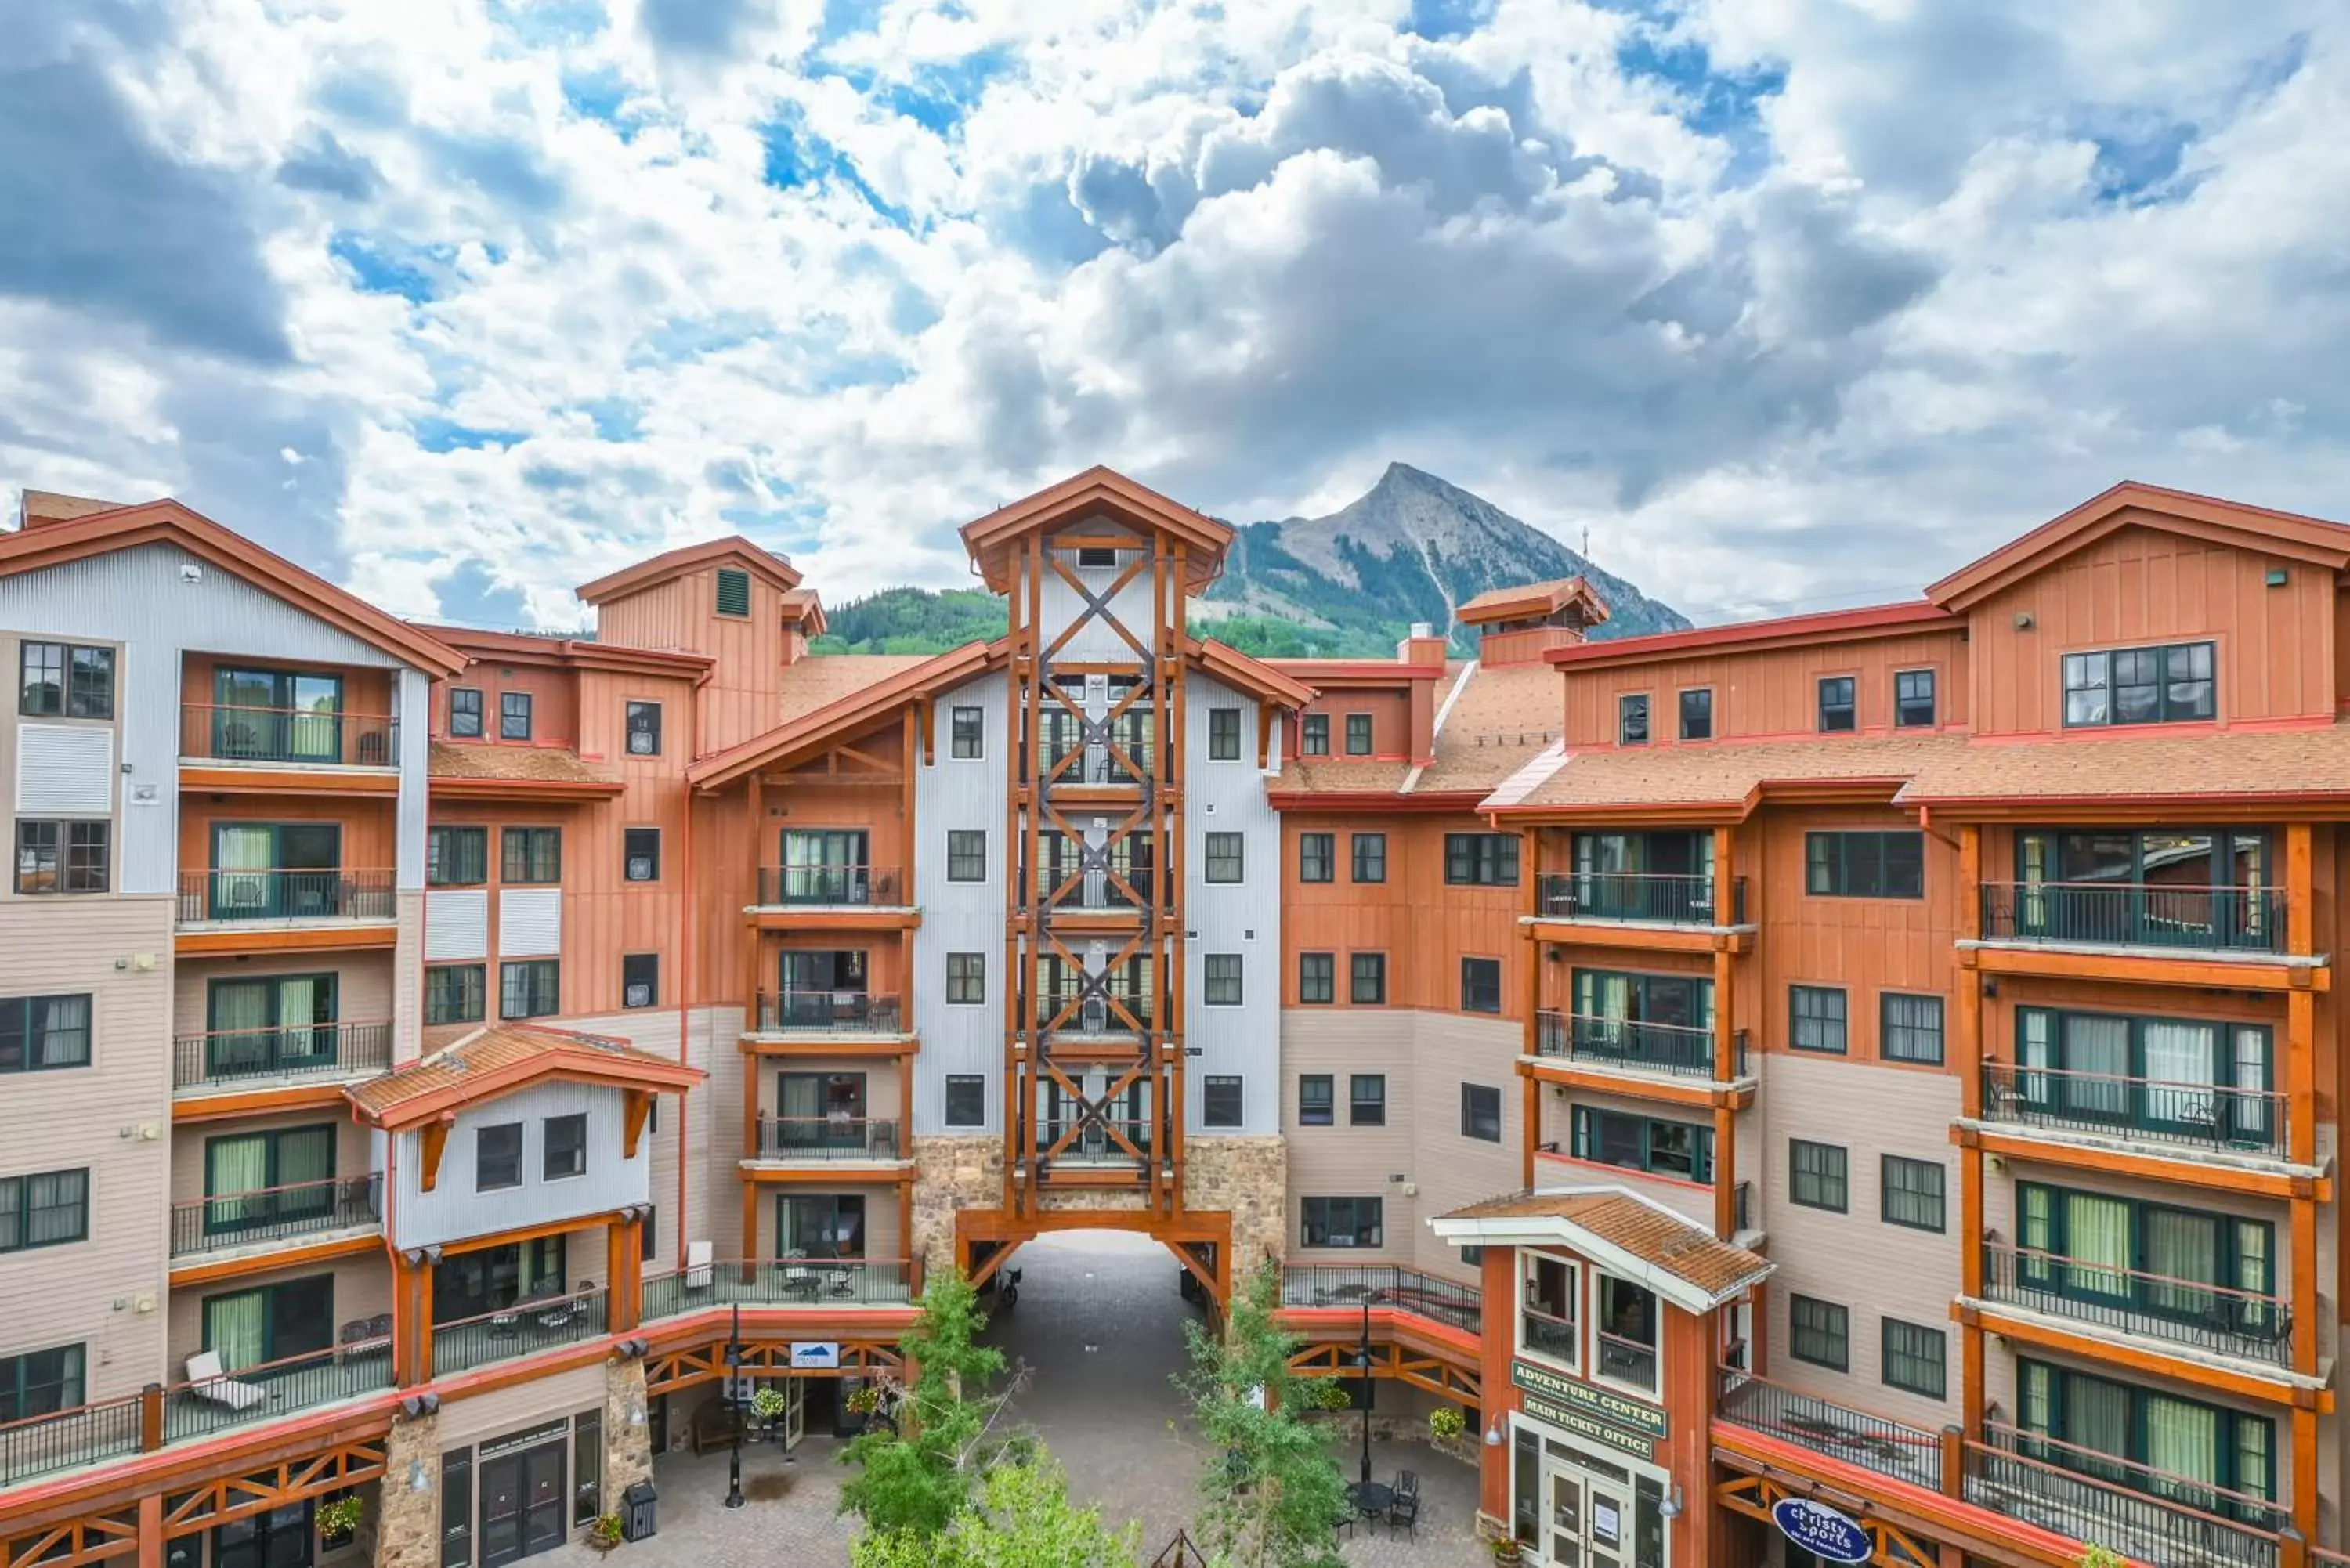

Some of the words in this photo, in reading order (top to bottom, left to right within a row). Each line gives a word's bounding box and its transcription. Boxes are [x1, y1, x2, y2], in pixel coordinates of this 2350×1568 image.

[1516, 1365, 1597, 1403] ADVENTURE
[1600, 1396, 1661, 1425] CENTER
[1527, 1400, 1556, 1420] MAIN
[1558, 1411, 1602, 1435] TICKET
[1603, 1429, 1649, 1453] OFFICE
